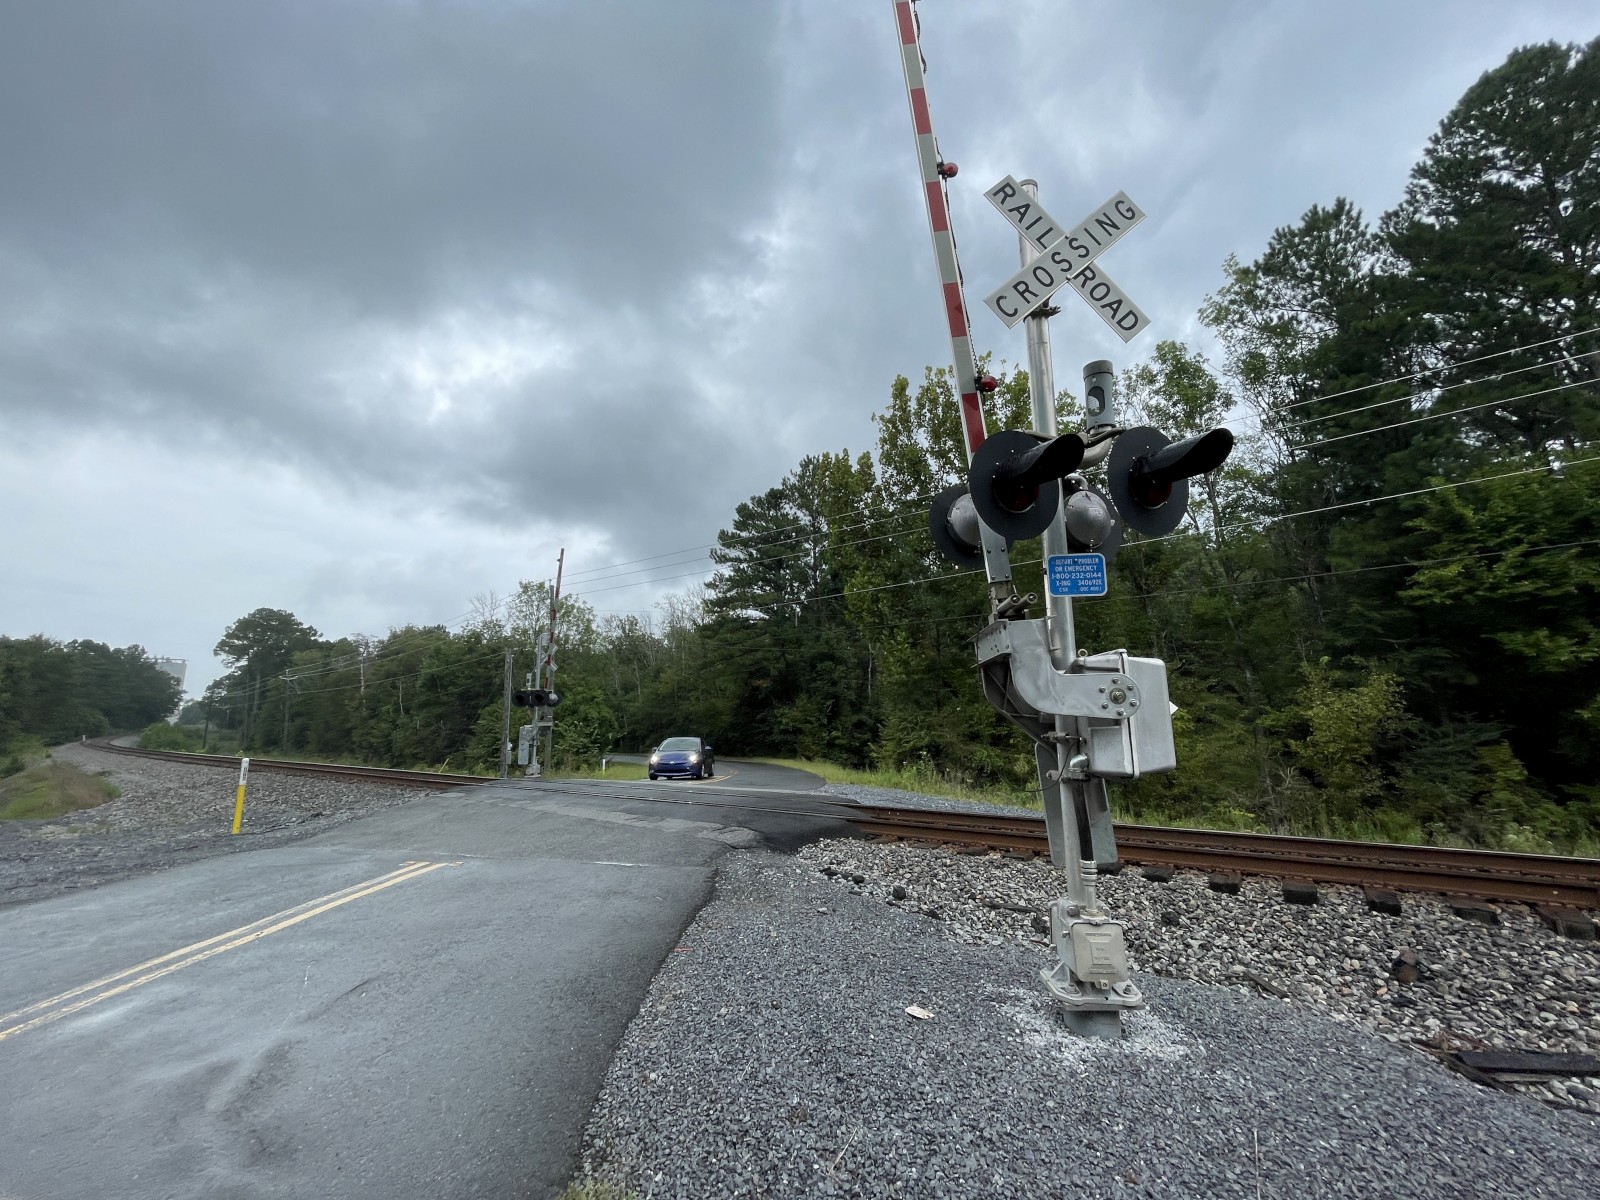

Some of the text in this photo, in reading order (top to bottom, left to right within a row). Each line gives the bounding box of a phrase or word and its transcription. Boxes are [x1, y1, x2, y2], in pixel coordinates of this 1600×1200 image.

[992, 182, 1139, 331] RAIL ROAD
[996, 200, 1136, 318] CROSSING
[1051, 572, 1102, 580] 1-800-232-0144
